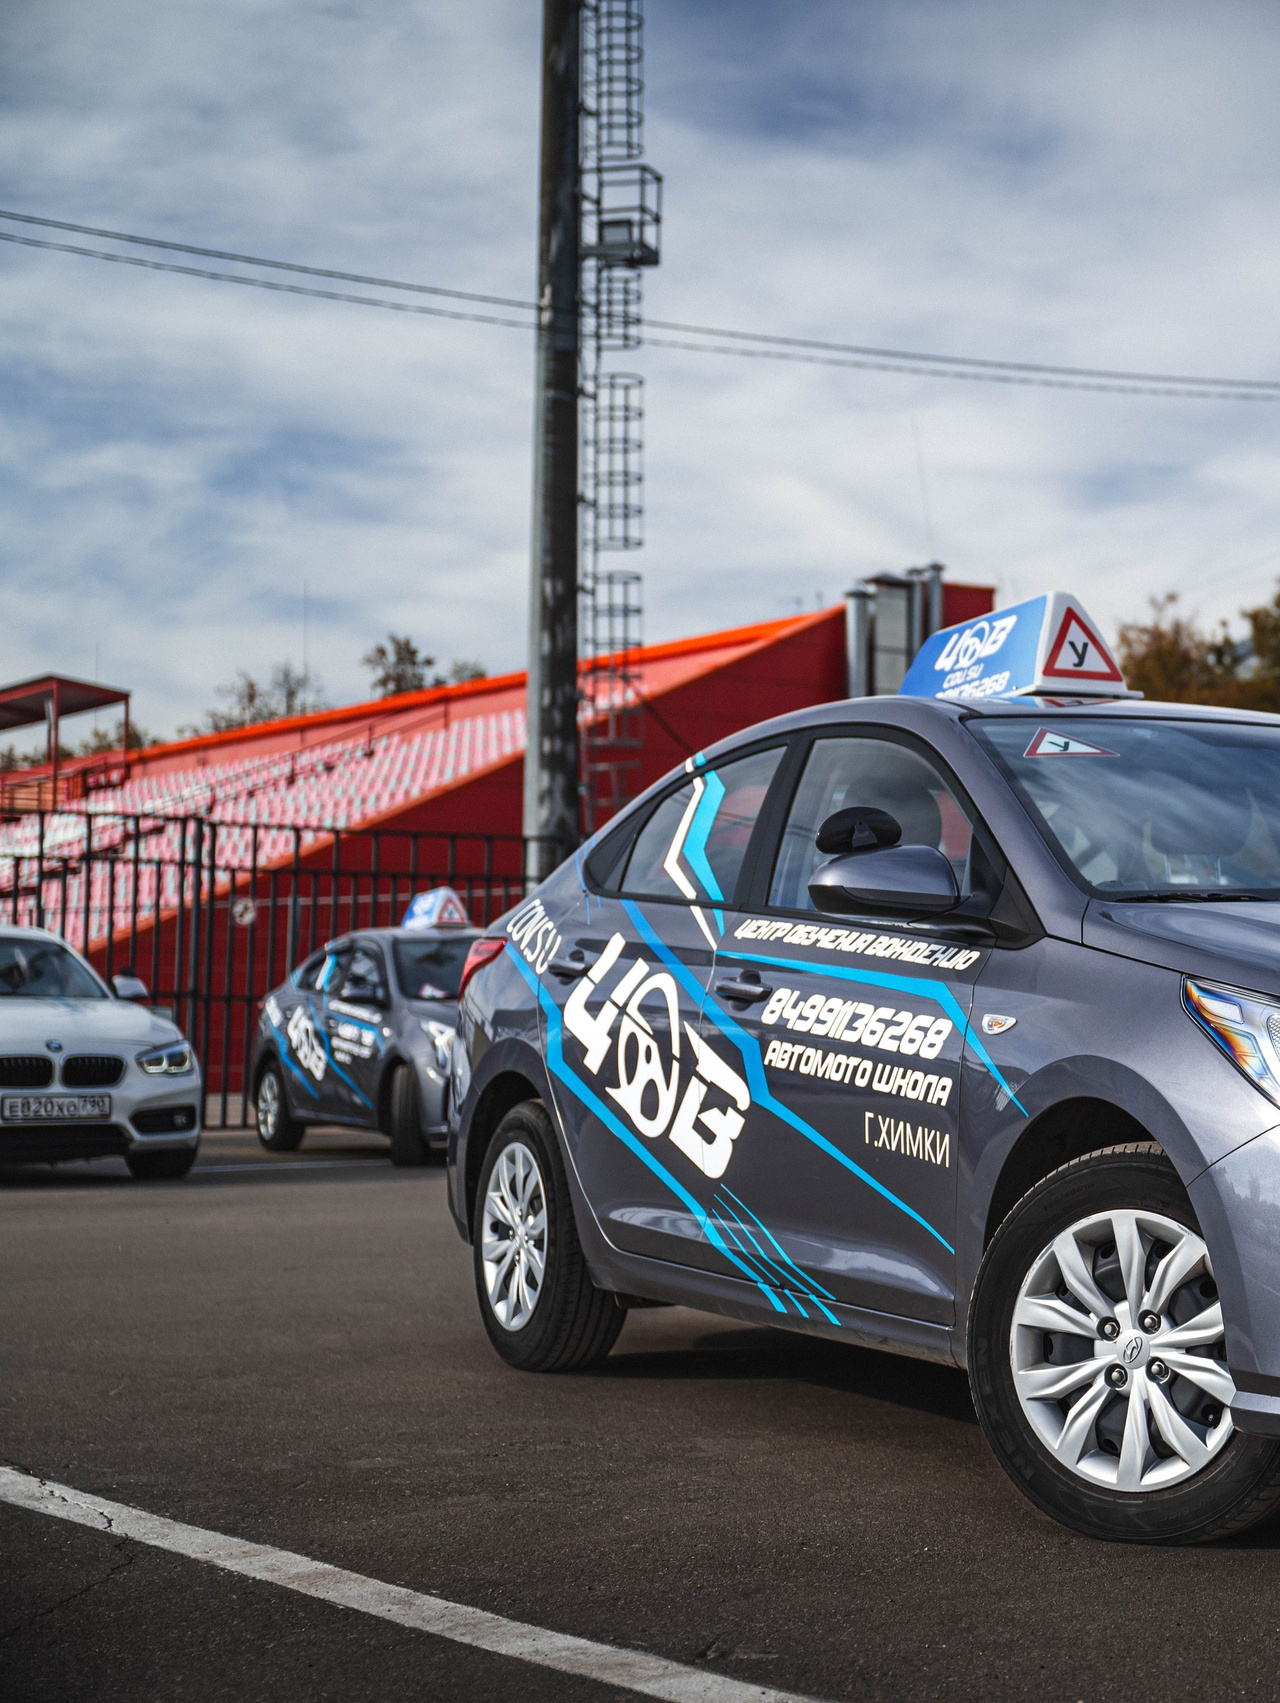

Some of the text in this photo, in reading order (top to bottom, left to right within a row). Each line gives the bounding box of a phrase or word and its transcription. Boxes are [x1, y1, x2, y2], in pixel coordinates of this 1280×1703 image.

[734, 919, 980, 970] ЦЕНТР ОБУЧЕНИЯ ВОЖДЕНИЮ
[761, 987, 953, 1060] 84991136268
[764, 1040, 953, 1107] АВТОМОТО ШКОЛА
[865, 1111, 950, 1168] Г.ХИМКИ
